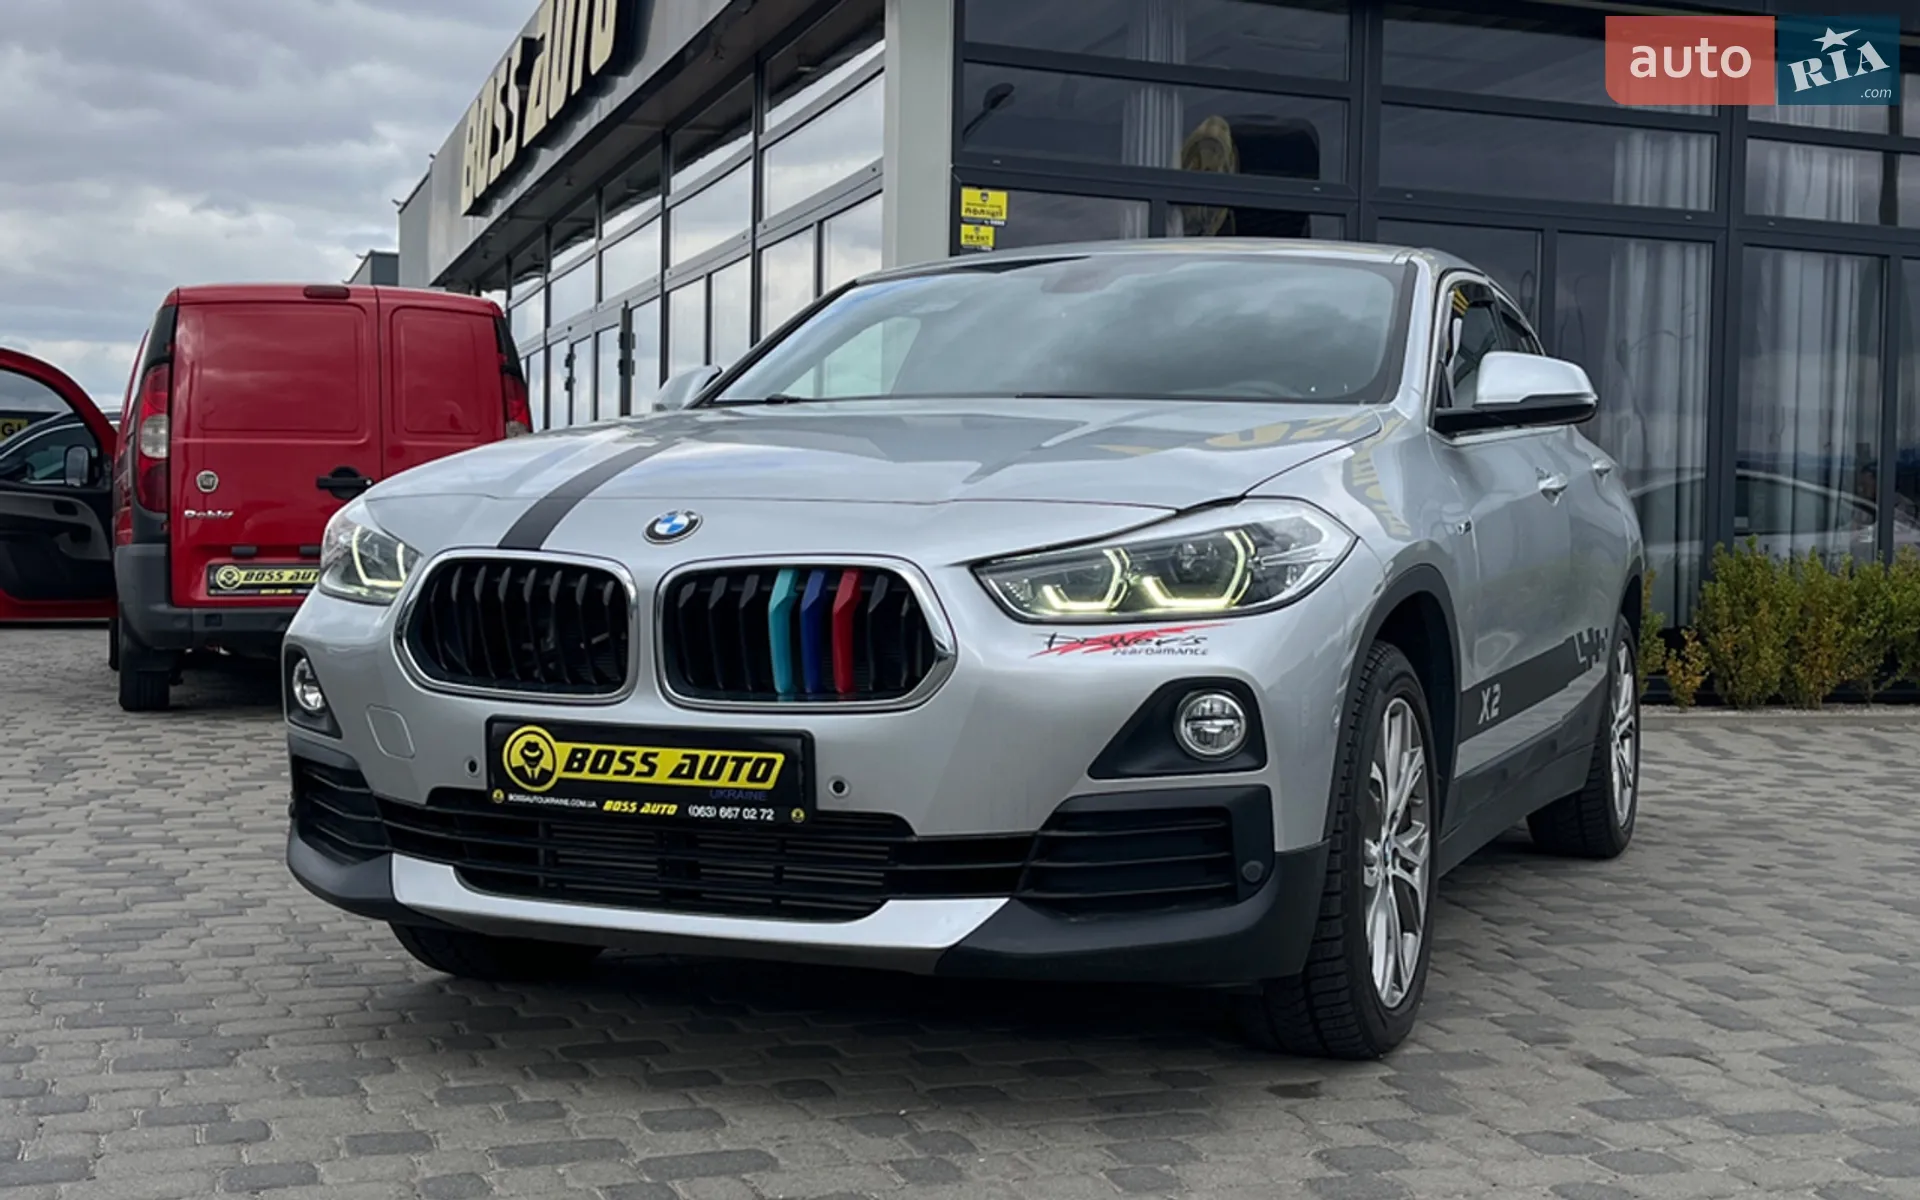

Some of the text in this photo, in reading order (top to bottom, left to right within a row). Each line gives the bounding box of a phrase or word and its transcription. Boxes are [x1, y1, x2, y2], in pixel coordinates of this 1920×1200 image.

[462, 36, 523, 216] BOSS
[244, 571, 320, 582] BOSS AUT
[1478, 683, 1501, 724] X2
[563, 747, 778, 783] BOSS AUTO
[710, 789, 767, 800] UKRAINE
[603, 800, 678, 815] BOSS AUTO
[688, 804, 775, 821] (063) 667 02 72
